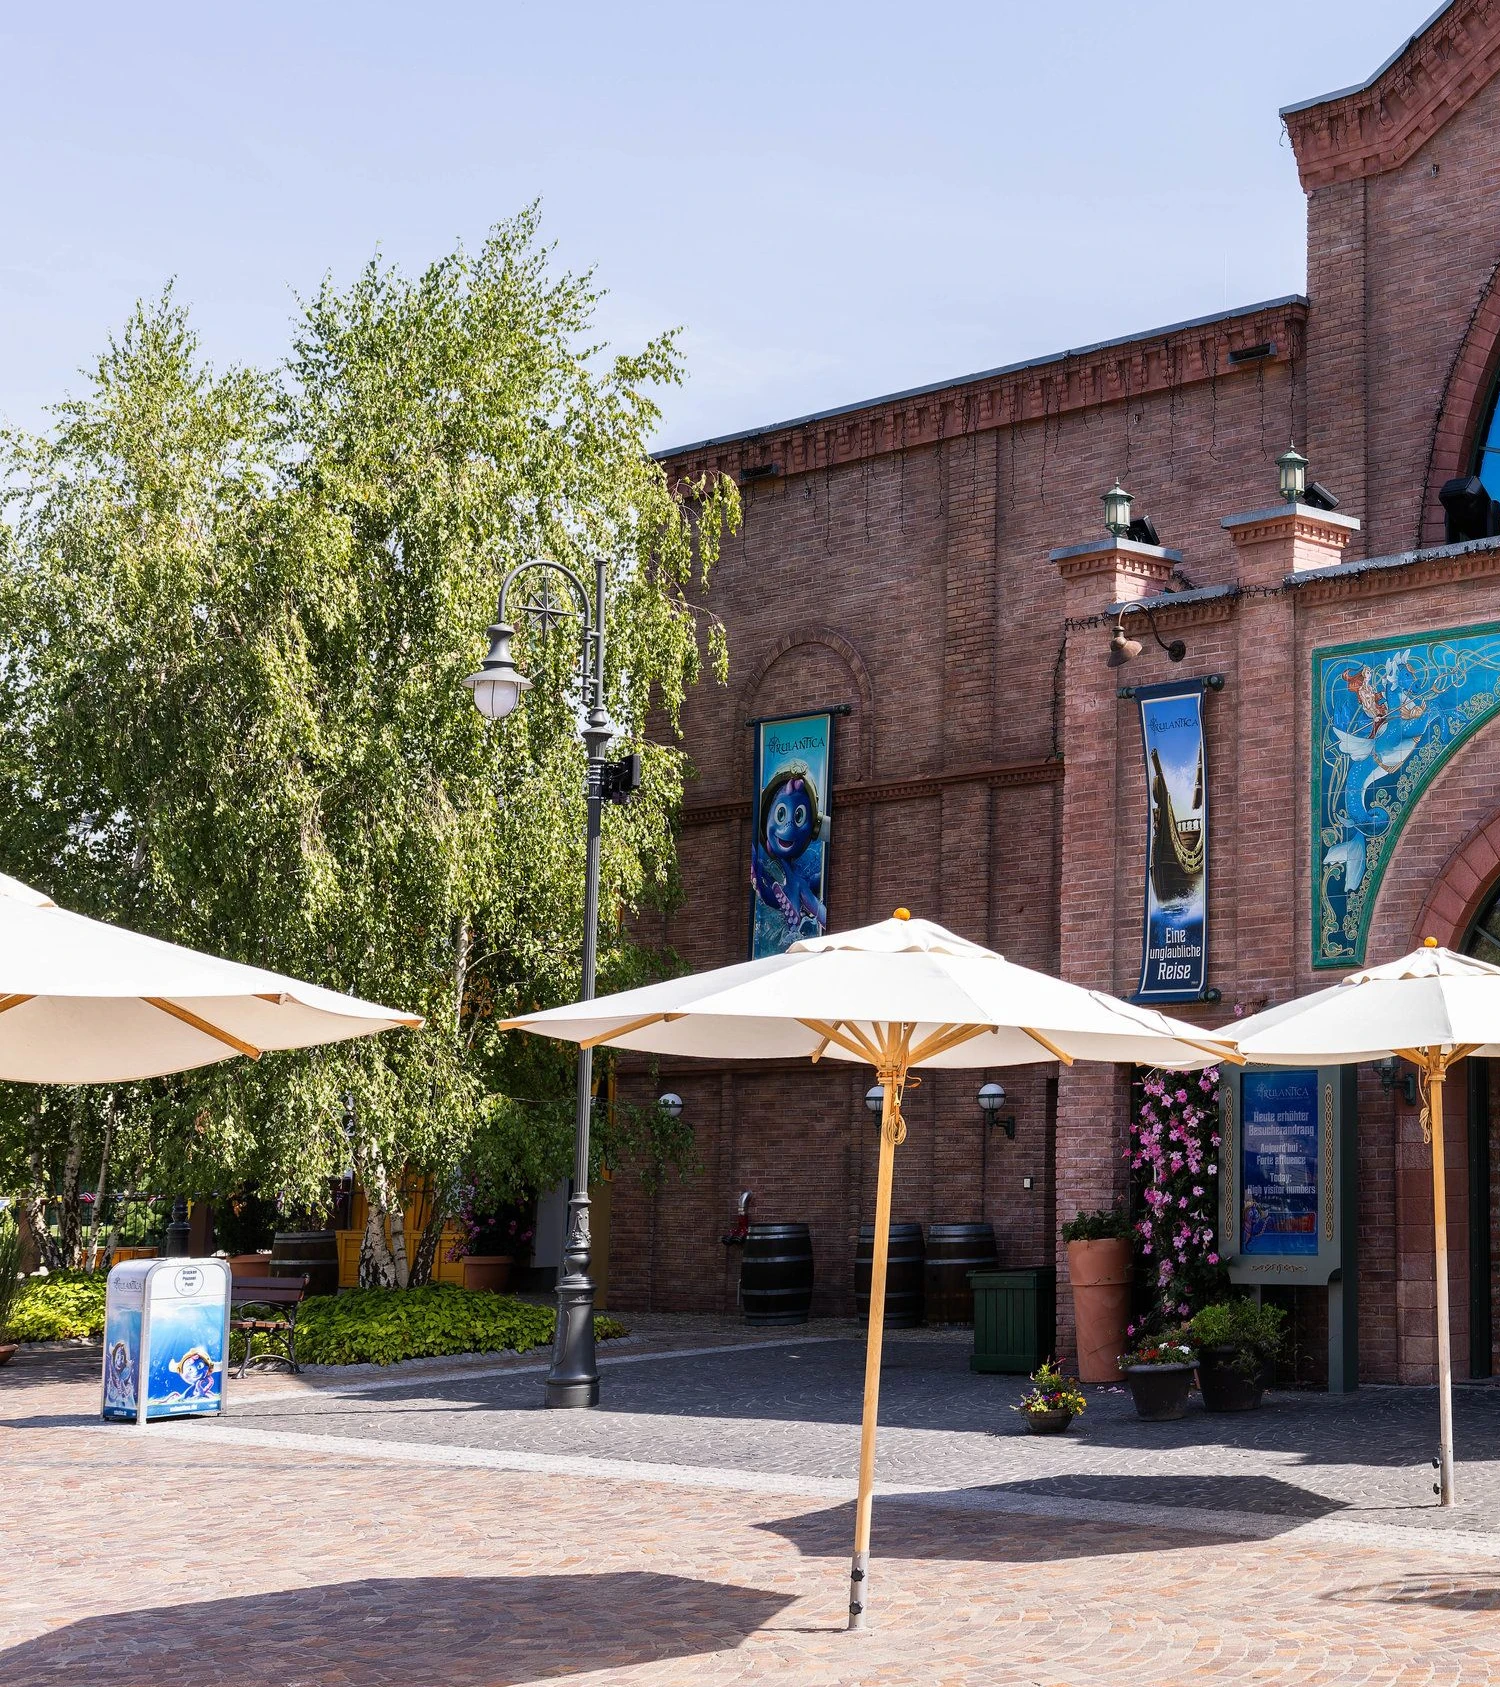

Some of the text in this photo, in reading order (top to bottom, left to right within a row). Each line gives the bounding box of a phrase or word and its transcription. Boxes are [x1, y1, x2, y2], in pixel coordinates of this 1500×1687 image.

[774, 735, 826, 756] RULANTICA
[1165, 927, 1186, 944] Eine
[1149, 944, 1201, 961] unglaubliche
[1157, 962, 1191, 980] Reise
[1253, 1110, 1309, 1122] Heute erhöhter
[1248, 1124, 1315, 1137] Besucherandrang
[1256, 1155, 1274, 1165] Forte
[1269, 1172, 1292, 1184] Today:
[1247, 1184, 1316, 1196] High visitor numbers
